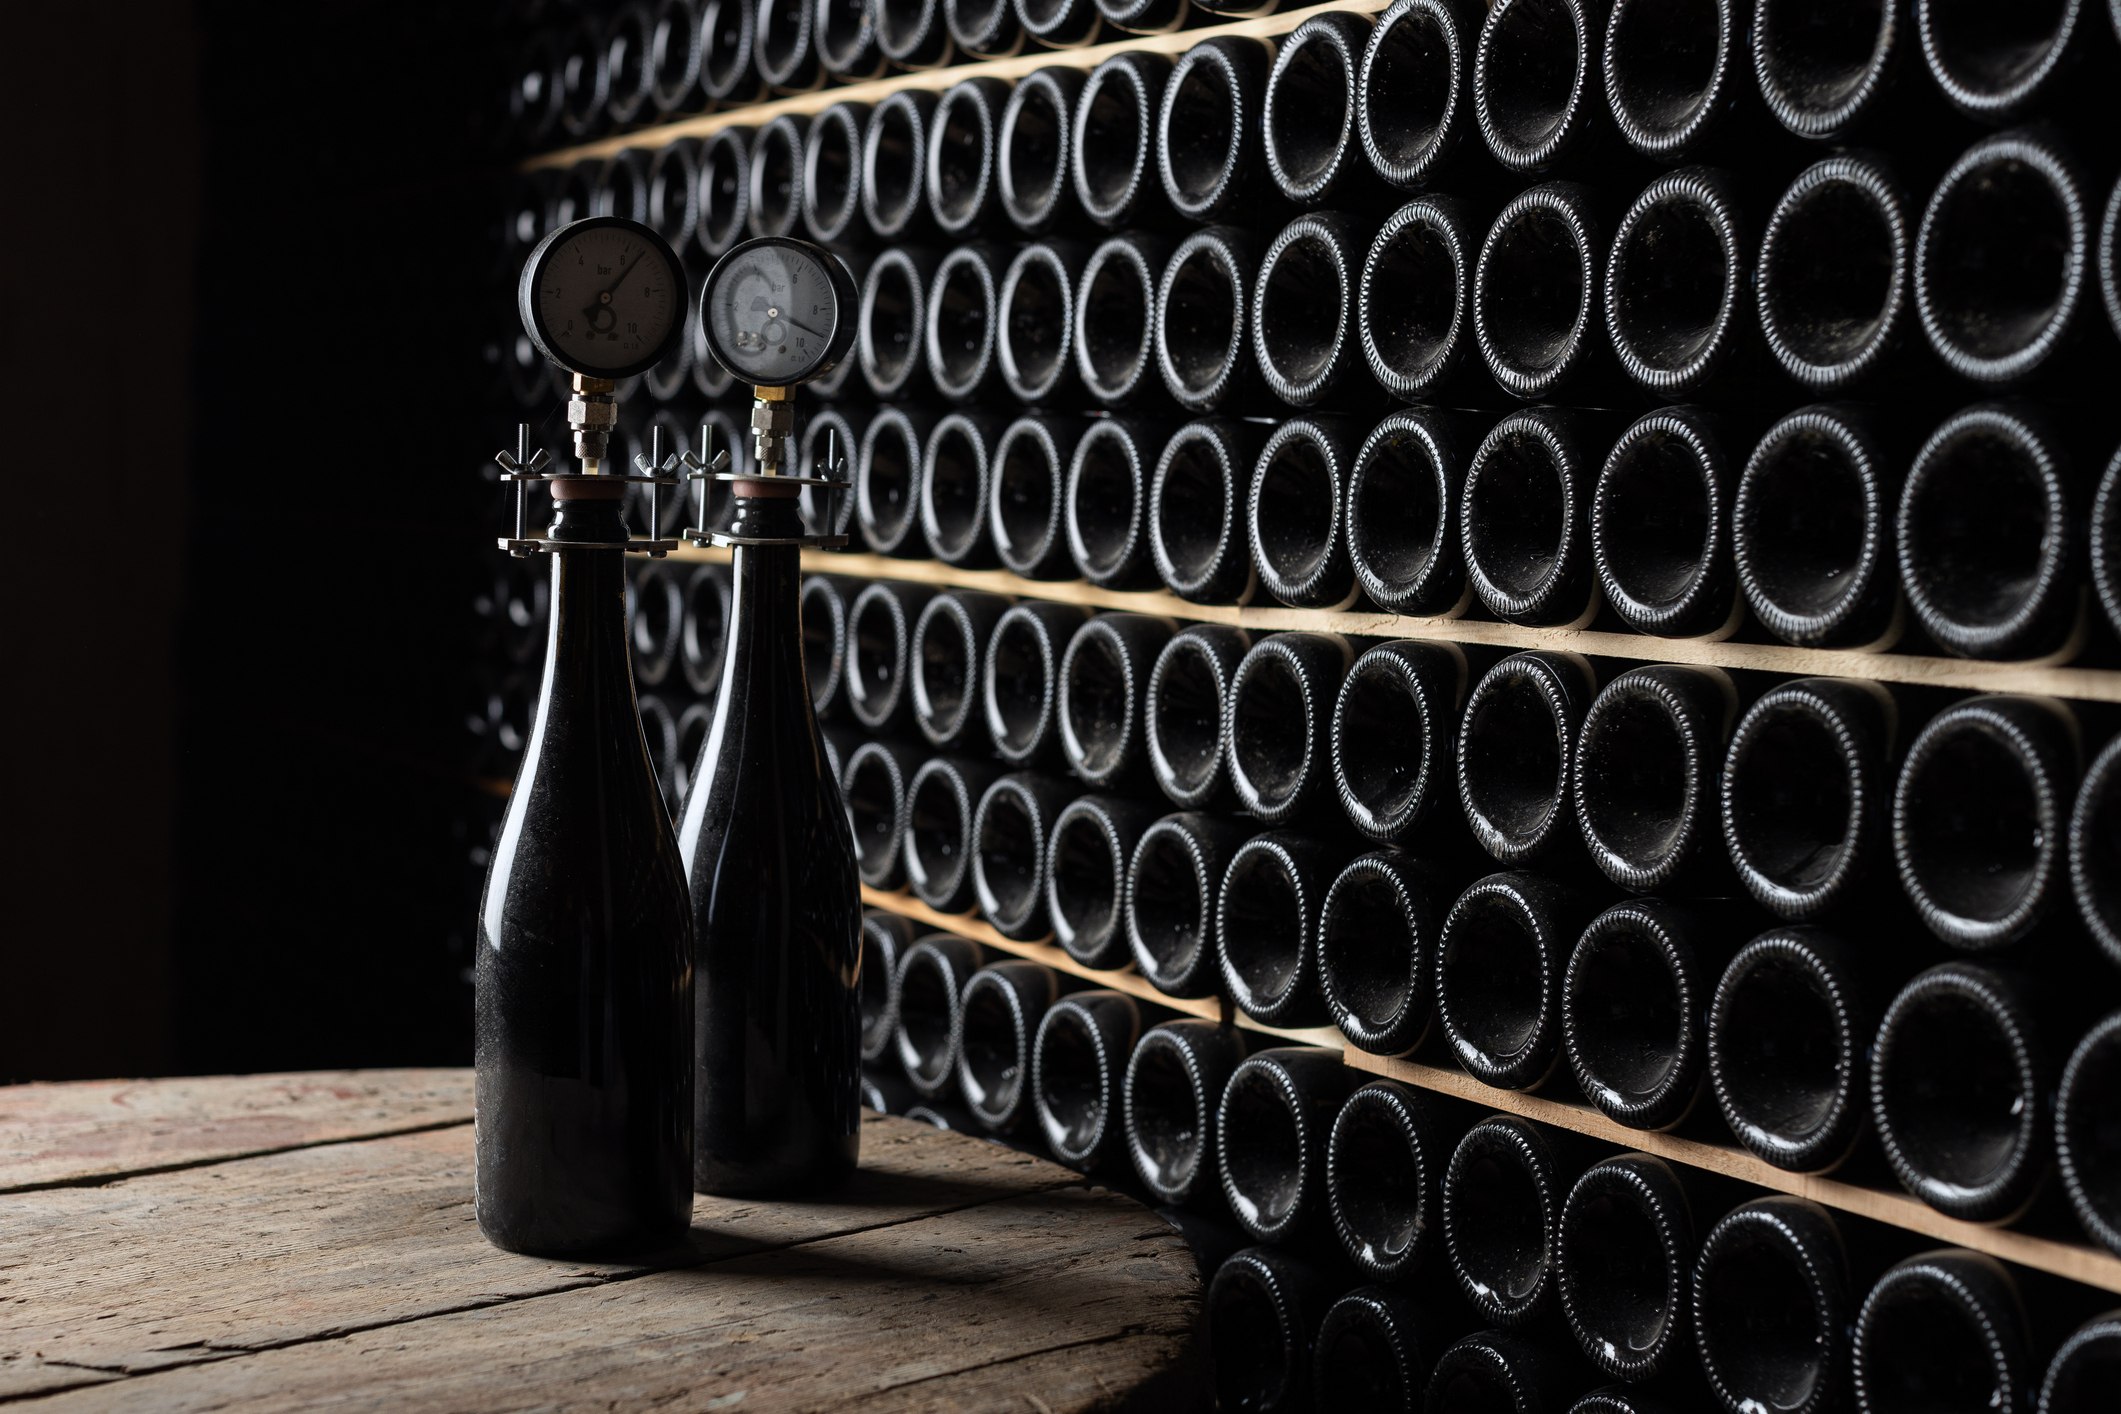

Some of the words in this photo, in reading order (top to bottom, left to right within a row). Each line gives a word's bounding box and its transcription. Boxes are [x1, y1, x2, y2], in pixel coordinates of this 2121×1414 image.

[578, 255, 584, 266] 4
[620, 255, 626, 266] 6
[597, 264, 612, 275] bar
[792, 274, 798, 284] 6
[644, 287, 650, 298] 8
[772, 282, 785, 292] bar
[556, 288, 561, 299] 2
[734, 302, 739, 311] 2
[813, 305, 818, 315] 8
[567, 320, 573, 331] 0
[627, 323, 637, 334] 10
[796, 337, 804, 348] 10
